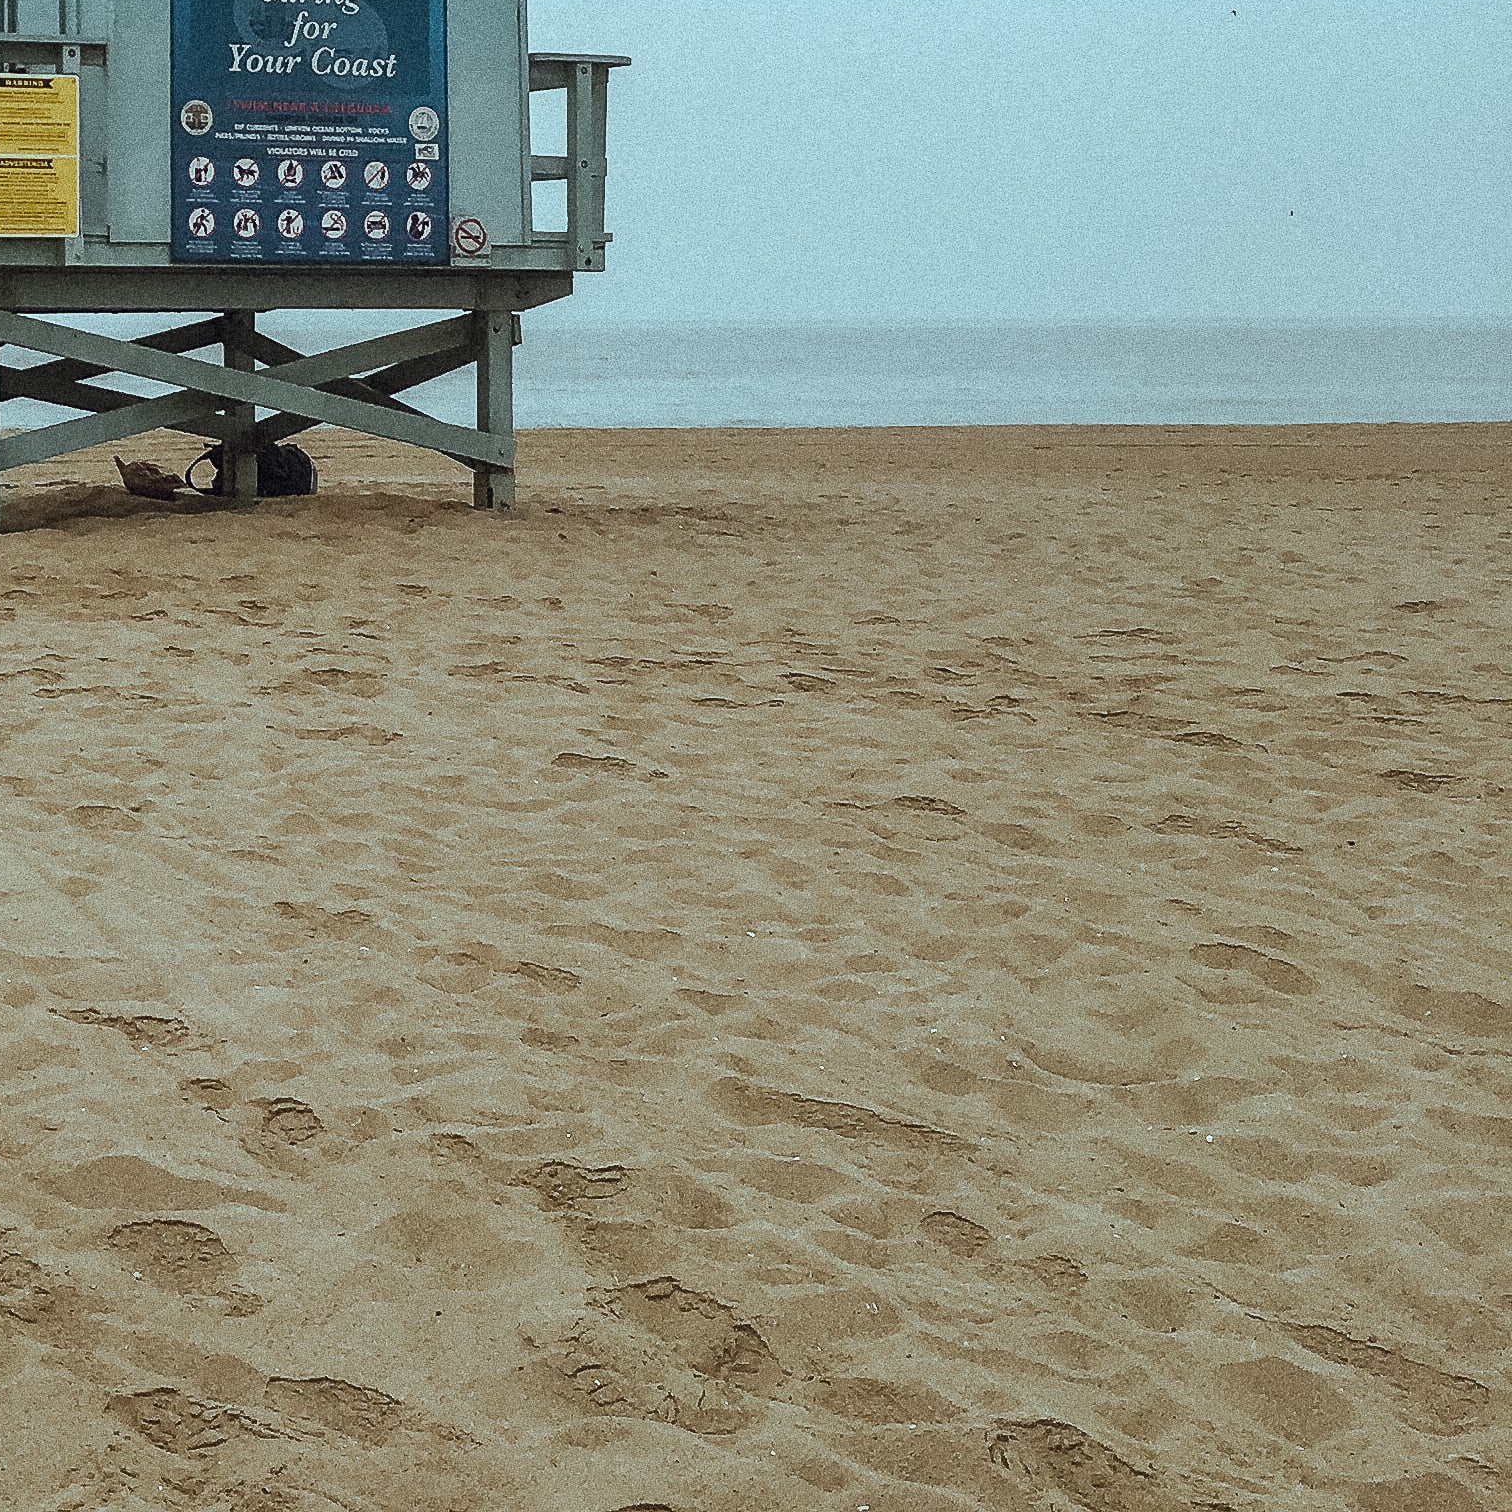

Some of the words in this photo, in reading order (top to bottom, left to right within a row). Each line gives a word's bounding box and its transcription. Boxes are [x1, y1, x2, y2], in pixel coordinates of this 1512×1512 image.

[284, 11, 337, 47] for
[228, 44, 302, 73] Your
[311, 46, 397, 77] Coast
[266, 147, 308, 156] VIOLATORS
[309, 148, 326, 156] WILL
[328, 148, 337, 156] BE
[339, 149, 358, 157] CITED
